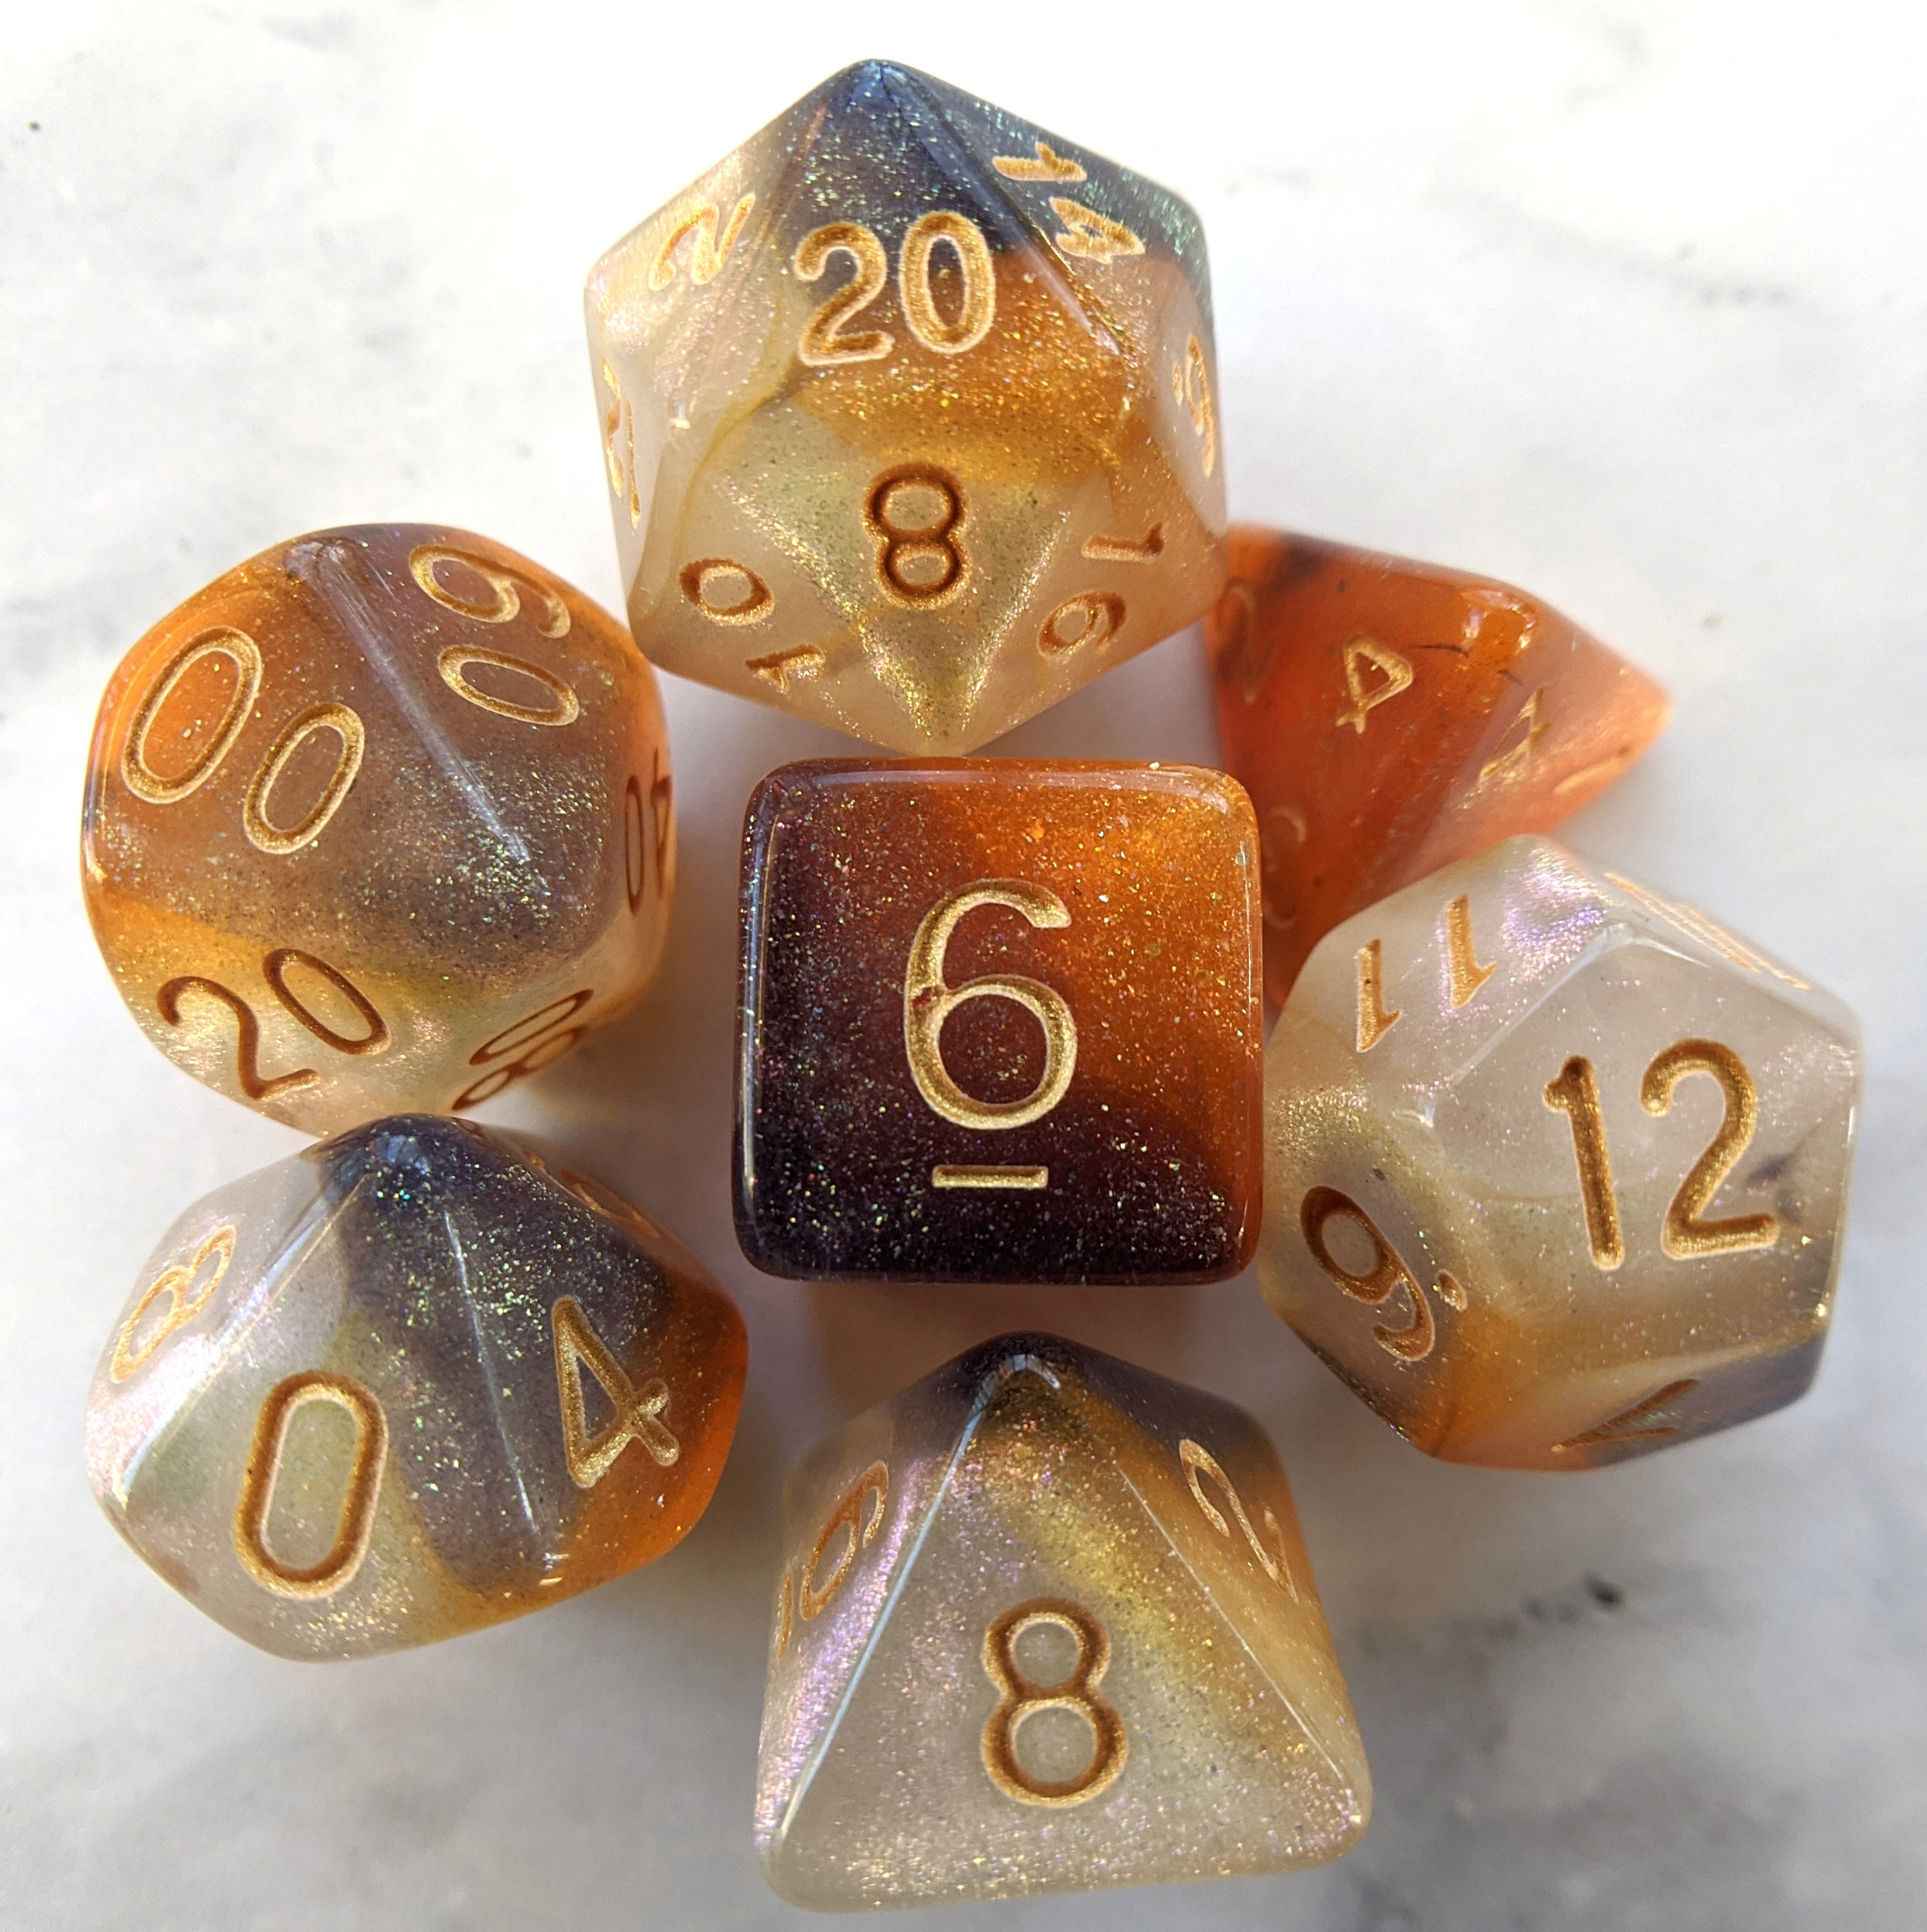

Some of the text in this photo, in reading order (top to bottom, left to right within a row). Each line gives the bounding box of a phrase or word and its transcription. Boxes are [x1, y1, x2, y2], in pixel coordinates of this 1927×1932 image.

[648, 193, 757, 290] 2
[795, 210, 996, 366] 20
[862, 462, 969, 609] 8
[1336, 637, 1413, 735] 4
[156, 948, 392, 1101] 20
[904, 879, 1079, 1130] 6
[1543, 1037, 1780, 1271] 12
[111, 1225, 236, 1383] 8
[552, 1295, 679, 1489] 4
[232, 1370, 389, 1600] 0
[980, 1596, 1128, 1809] 8
